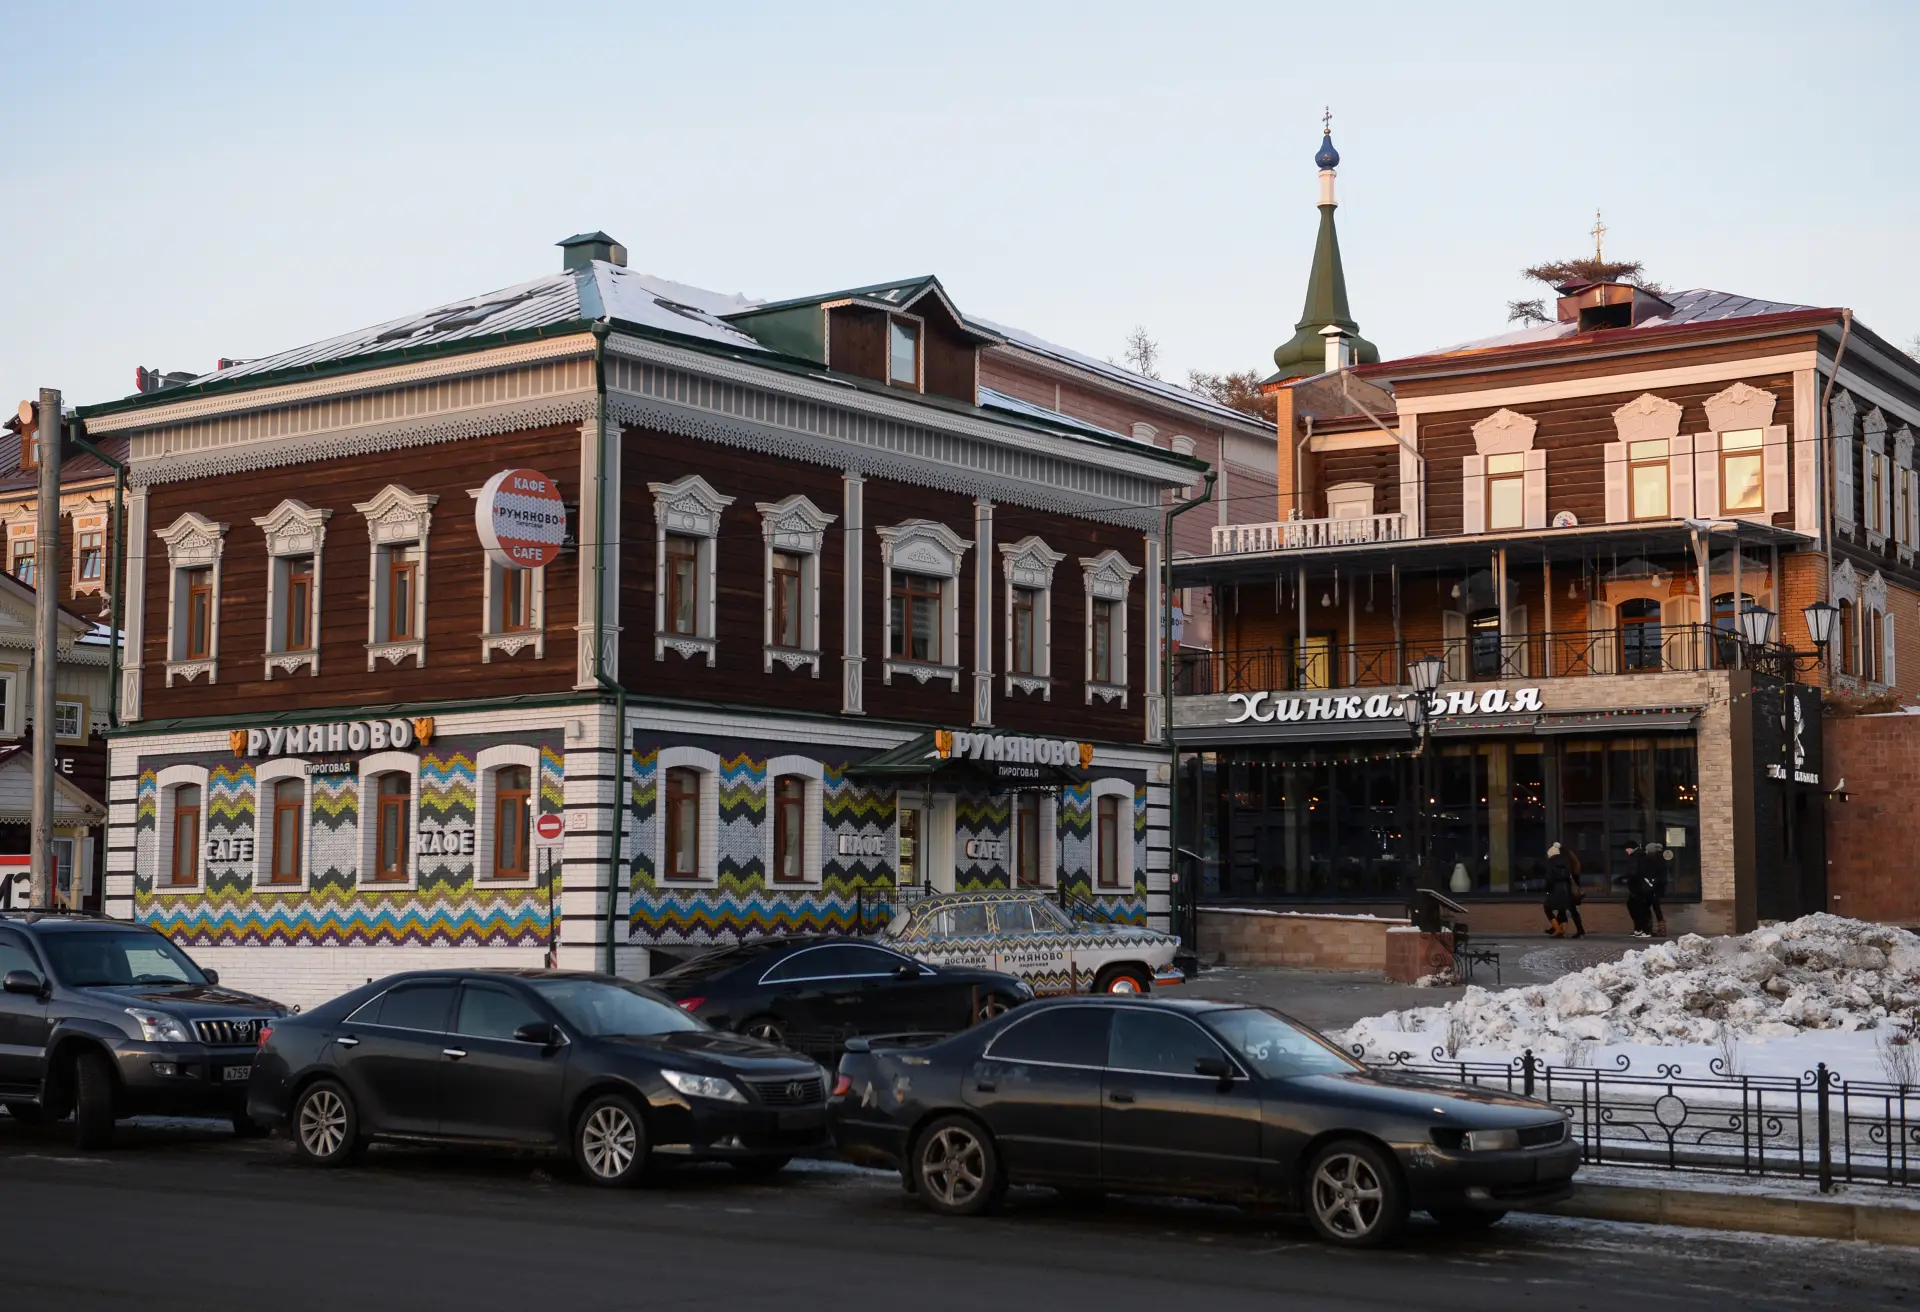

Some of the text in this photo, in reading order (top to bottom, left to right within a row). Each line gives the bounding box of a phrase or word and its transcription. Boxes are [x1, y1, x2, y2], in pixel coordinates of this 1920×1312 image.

[514, 477, 546, 493] КАФЕ
[500, 507, 559, 525] РУМЯНОВО
[513, 545, 543, 560] CAFE
[248, 719, 413, 756] РУМЯНОВО
[952, 732, 1080, 767] РУМЯНОВО
[305, 763, 350, 774] ПИРОГОВАЯ
[999, 767, 1039, 778] ПИРОГОВАЯ
[1767, 764, 1819, 784] Хиальная
[205, 838, 254, 860] CAFE
[416, 829, 475, 854] КАФЕ
[840, 834, 886, 855] КАФЕ
[967, 839, 1004, 860] CAFE
[944, 957, 987, 965] ДОСТАВКА
[1004, 952, 1063, 963] РУМЯНОВО
